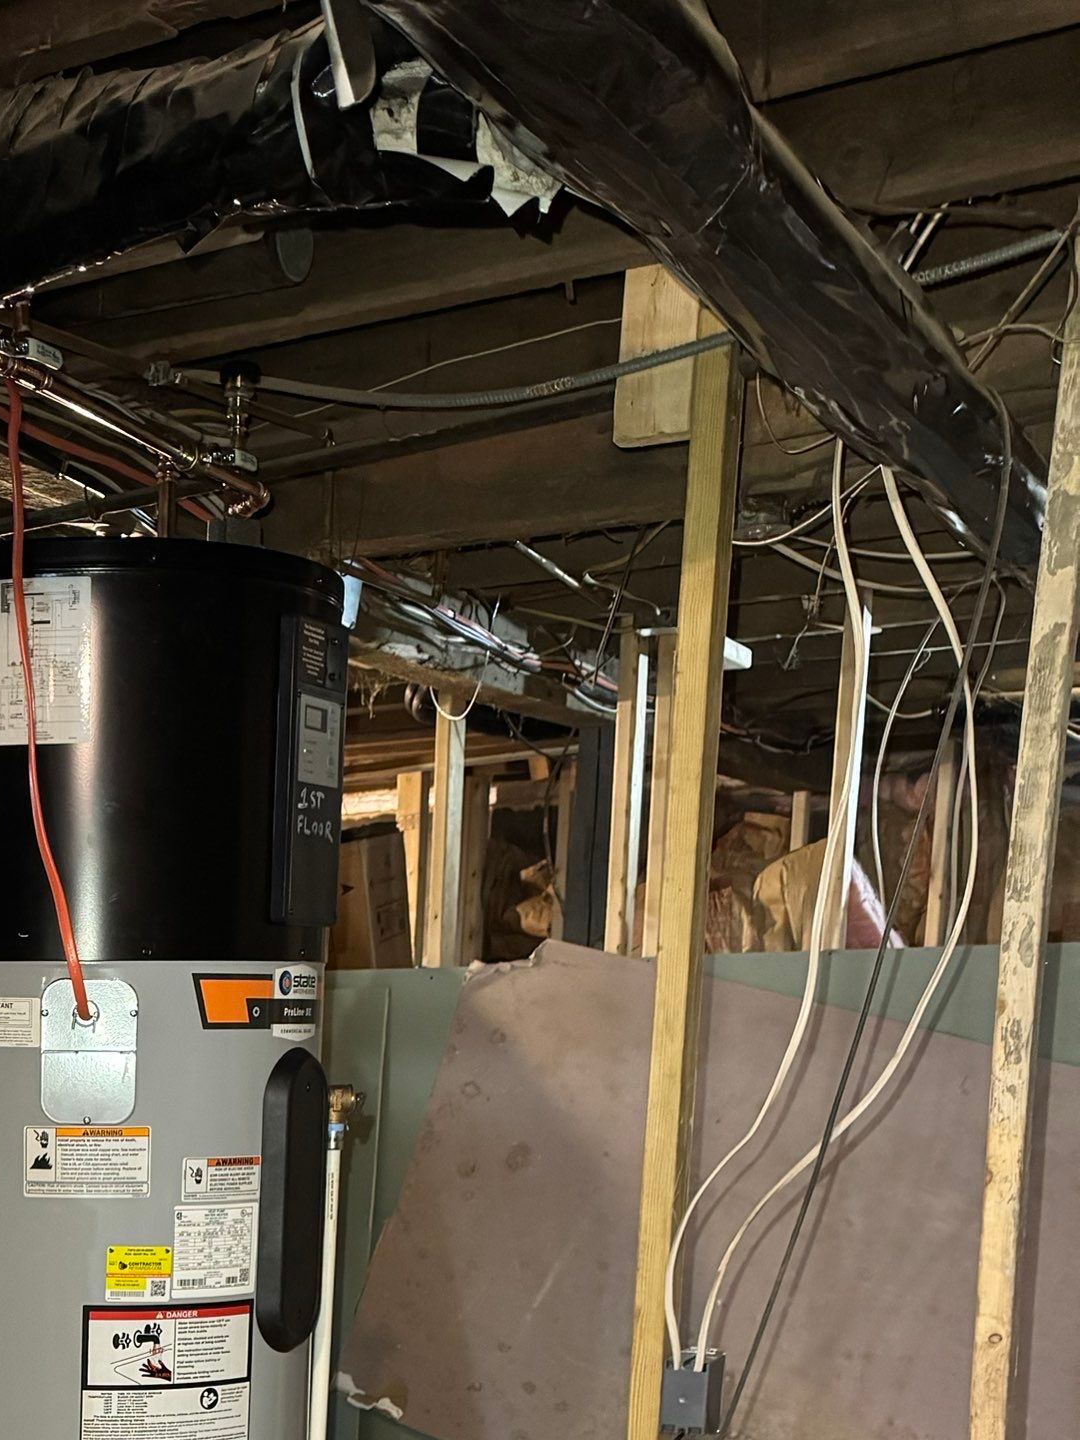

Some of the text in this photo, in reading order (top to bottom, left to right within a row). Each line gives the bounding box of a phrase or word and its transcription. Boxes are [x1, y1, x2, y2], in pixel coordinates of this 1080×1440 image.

[298, 787, 325, 809] 1ST
[297, 815, 333, 843] FLOOR
[293, 974, 315, 988] state
